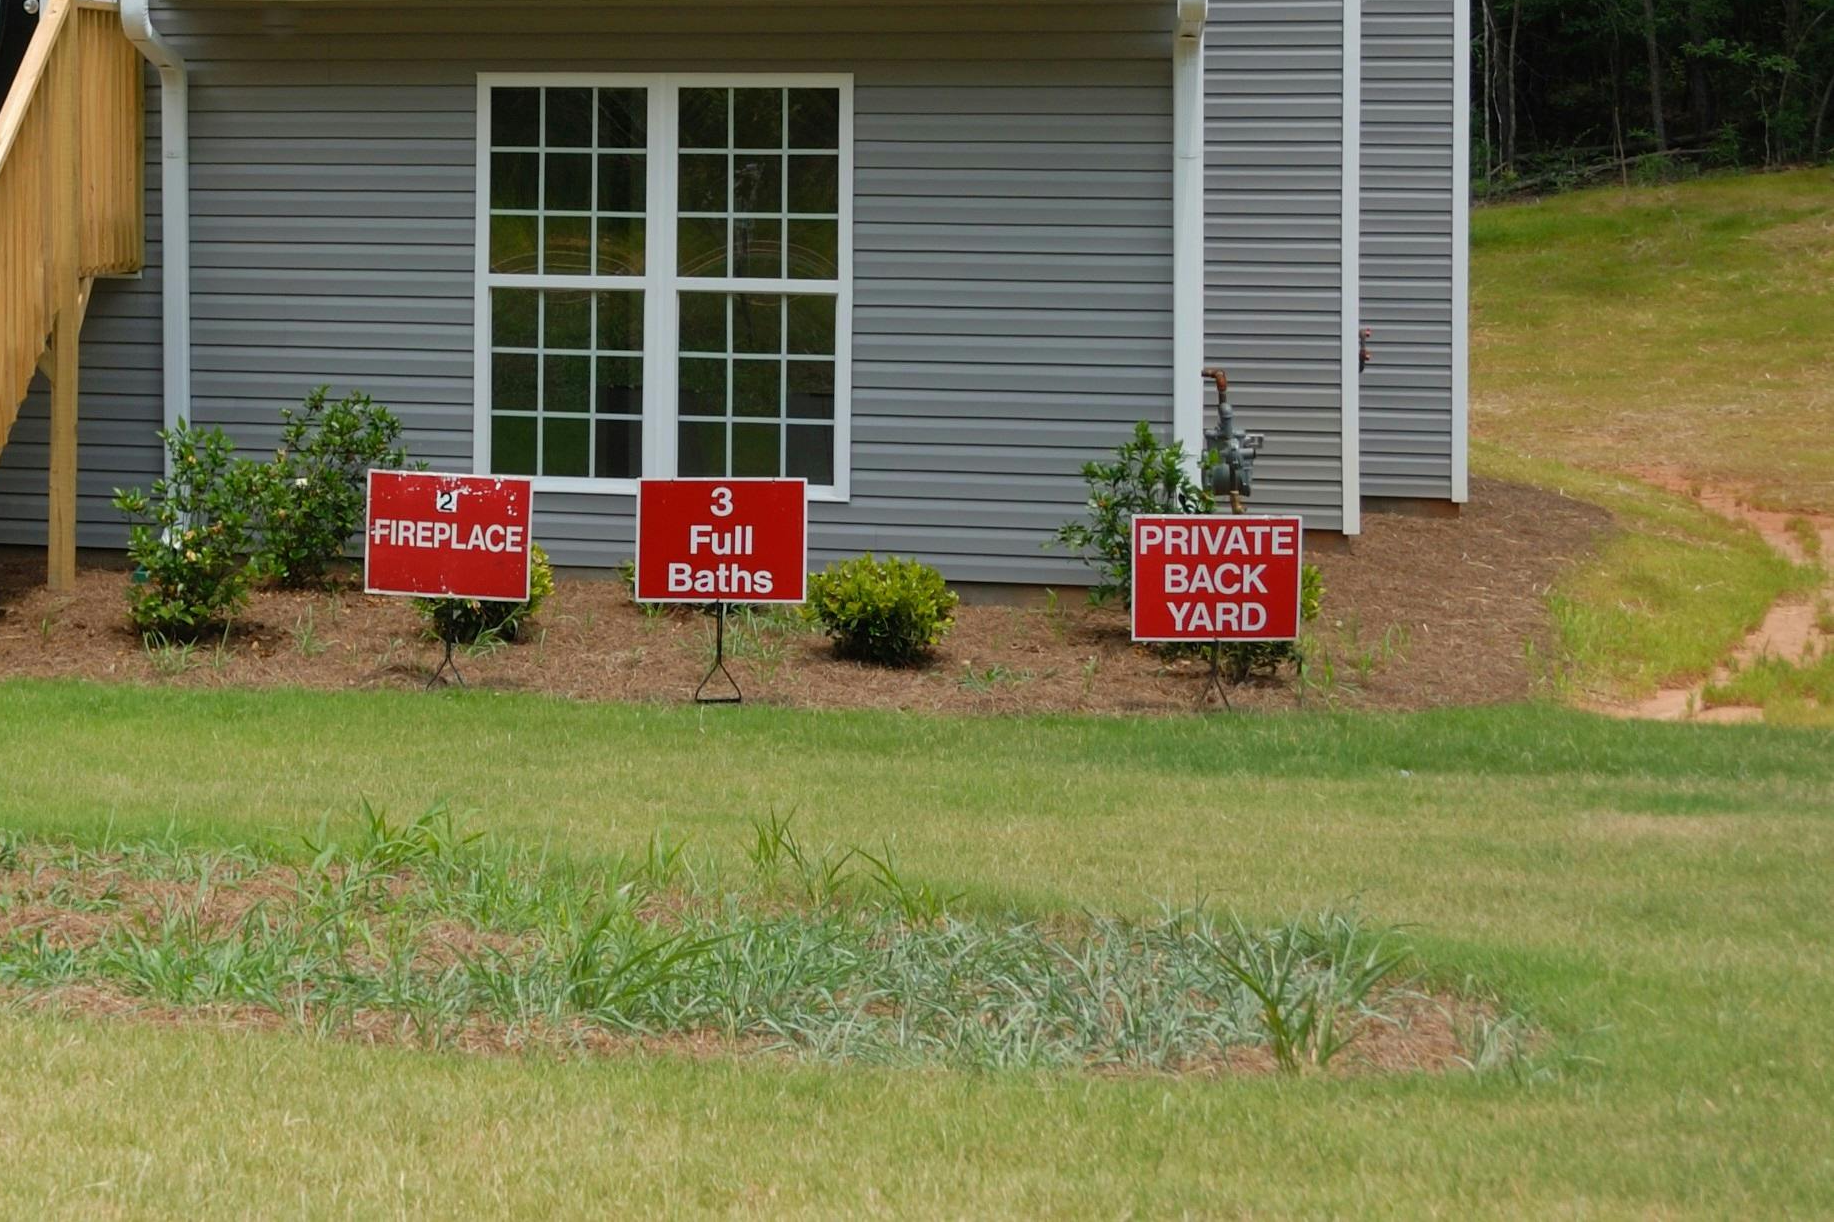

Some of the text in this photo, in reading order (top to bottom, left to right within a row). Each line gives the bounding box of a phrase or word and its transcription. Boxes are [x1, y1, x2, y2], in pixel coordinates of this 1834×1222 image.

[440, 492, 454, 511] 2
[710, 487, 733, 517] 3
[374, 519, 523, 553] FIREPLACE
[690, 525, 753, 555] Full
[1140, 526, 1294, 555] PRIVATE
[668, 563, 773, 594] Baths
[1165, 564, 1268, 594] BACK
[1167, 602, 1267, 631] YARD
